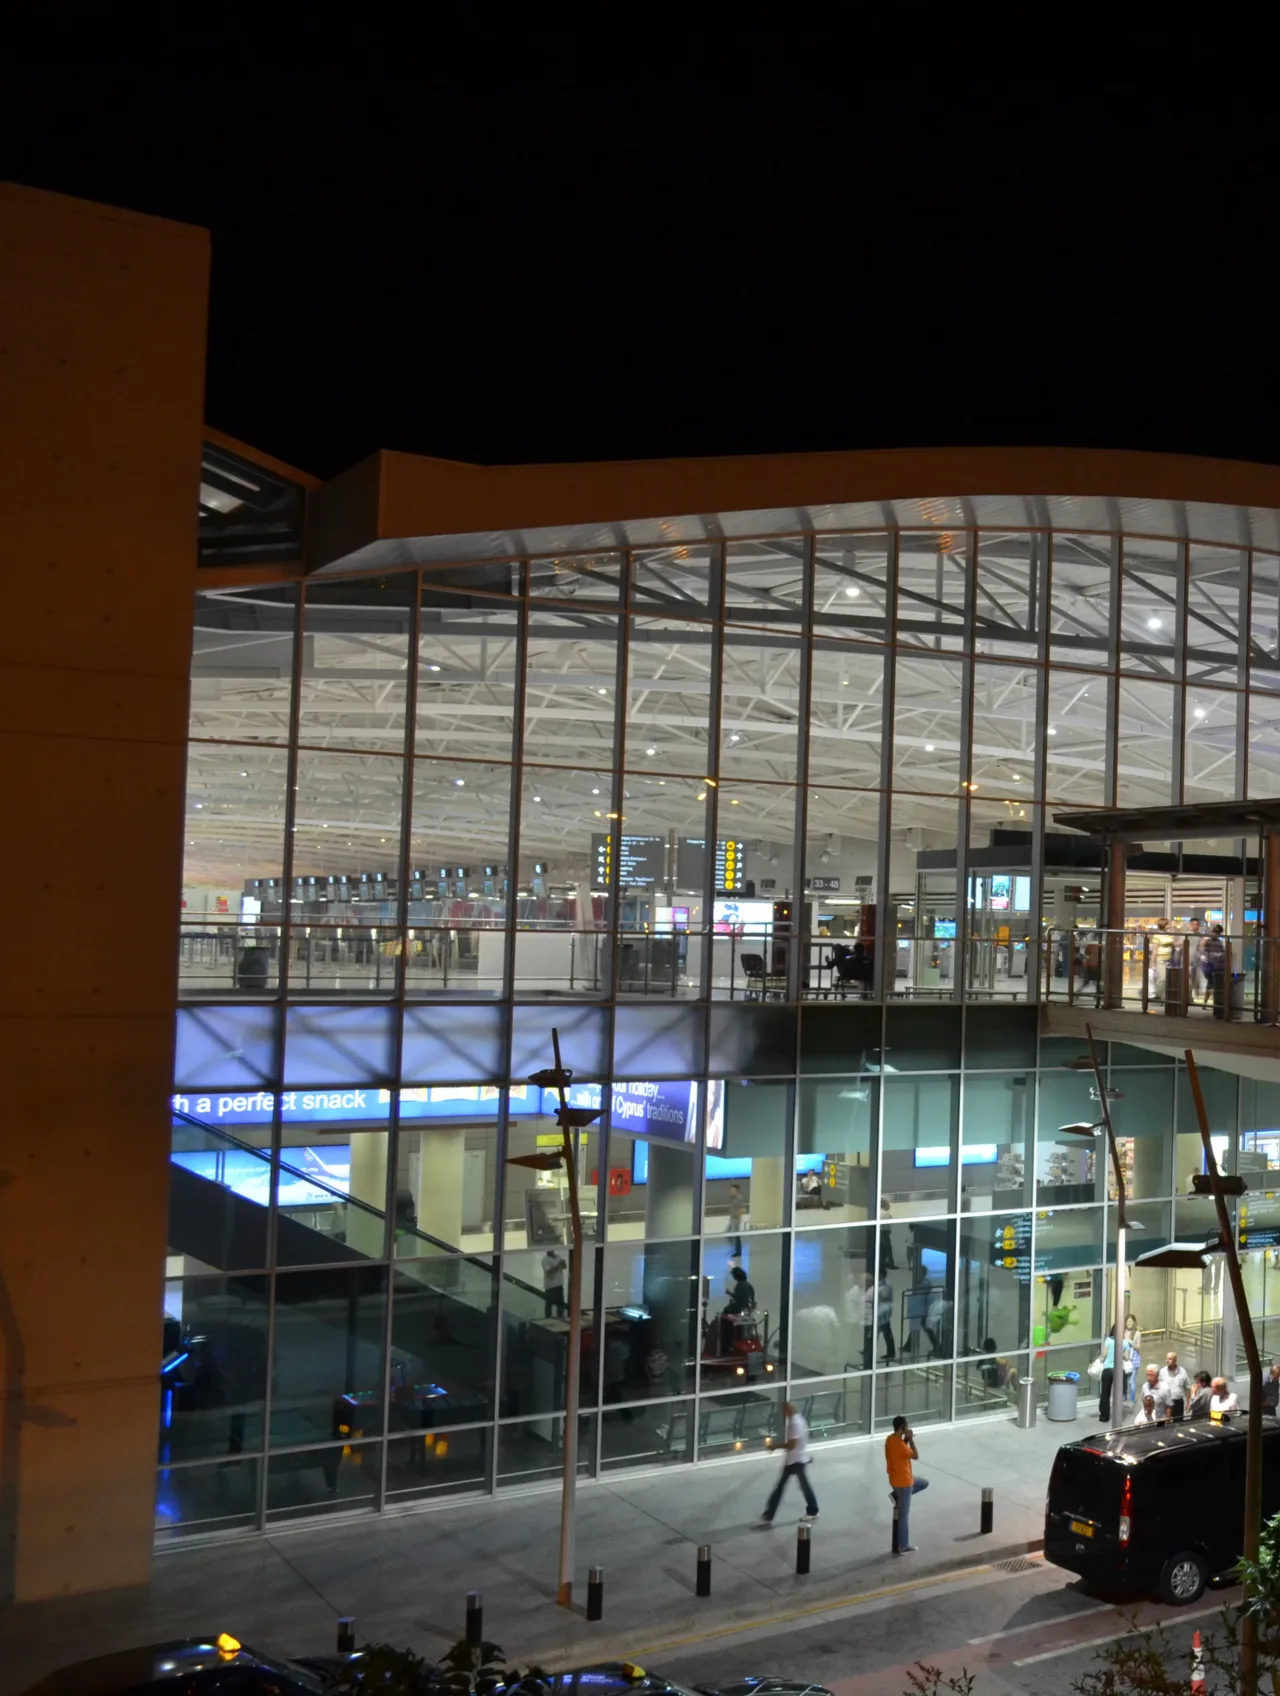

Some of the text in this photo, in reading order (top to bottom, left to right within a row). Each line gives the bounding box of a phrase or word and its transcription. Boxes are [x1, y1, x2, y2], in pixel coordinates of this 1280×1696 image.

[814, 879, 824, 888] 33
[196, 1098, 211, 1113] a
[303, 1089, 366, 1110] snack
[646, 1102, 685, 1125] traditions
